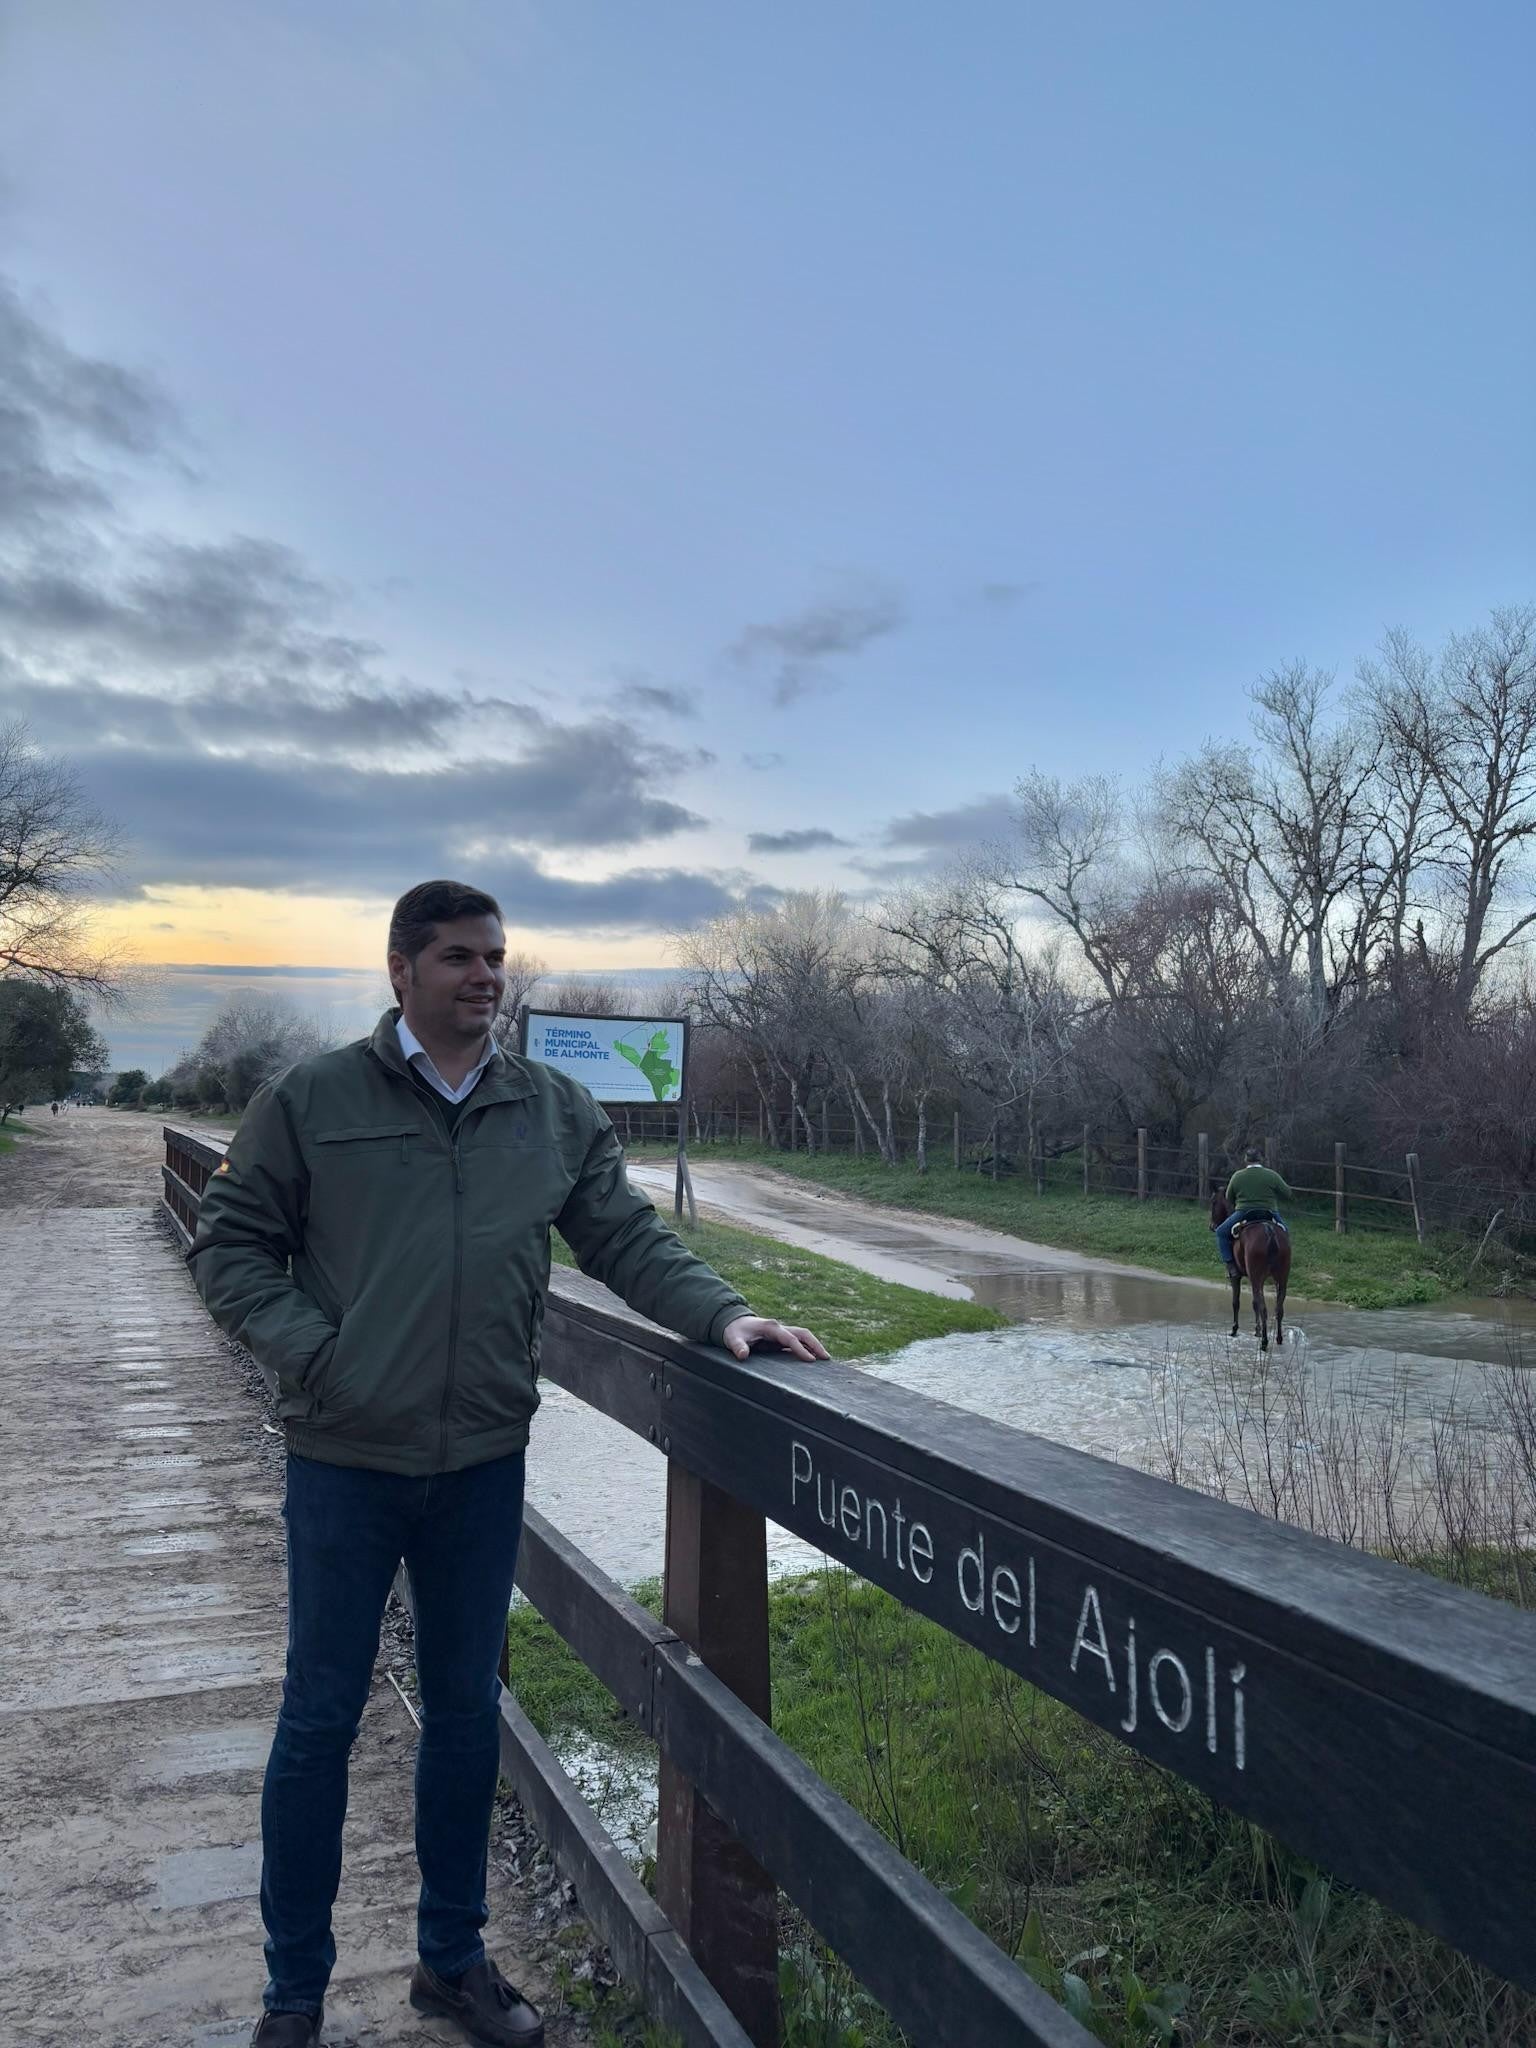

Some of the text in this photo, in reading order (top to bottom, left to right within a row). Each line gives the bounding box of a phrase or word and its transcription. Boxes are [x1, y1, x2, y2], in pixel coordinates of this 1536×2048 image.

[545, 1027, 591, 1039] TÉRMINO
[545, 1039, 600, 1050] MUNICIPAL
[544, 1048, 609, 1060] DE ALMONTE
[791, 1440, 934, 1584] Puente
[957, 1531, 1037, 1648] del
